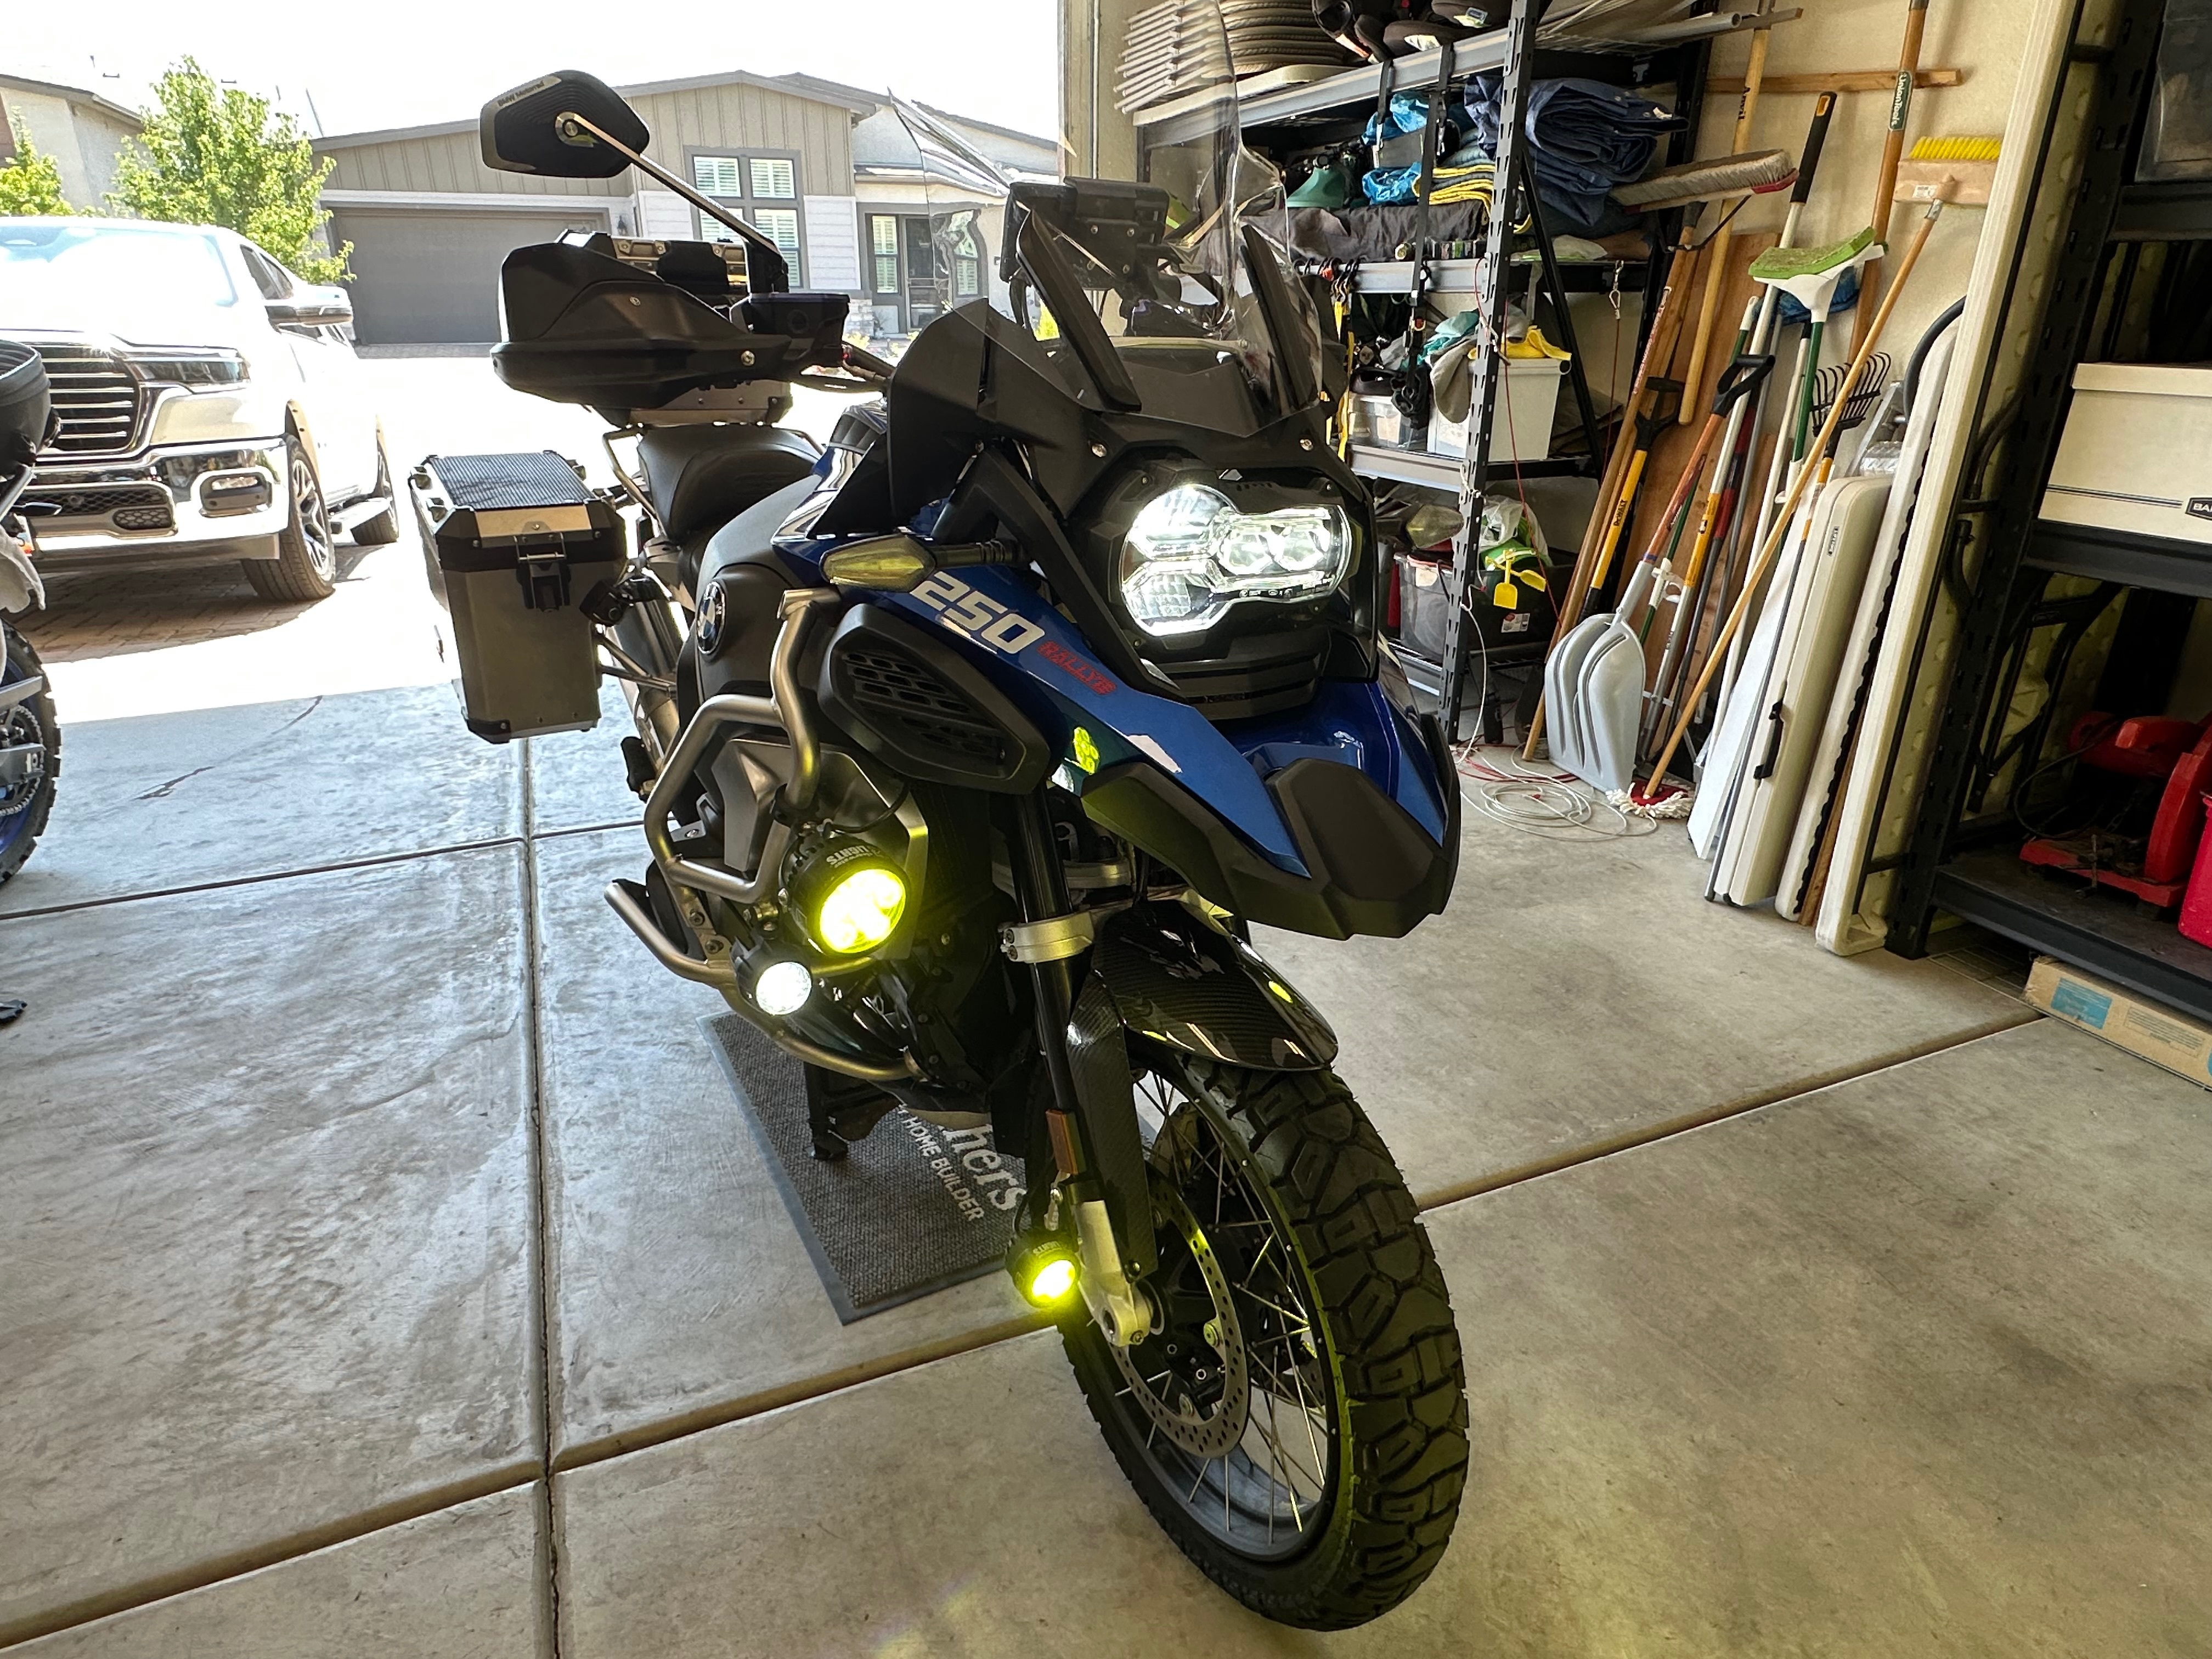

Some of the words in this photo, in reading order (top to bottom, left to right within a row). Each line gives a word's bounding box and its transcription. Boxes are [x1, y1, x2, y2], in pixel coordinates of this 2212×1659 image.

[1737, 87, 1751, 120] Anvil
[2193, 503, 2212, 512] BA
[826, 845, 870, 865] LIGHTS
[901, 1116, 942, 1156] HOME
[930, 1157, 984, 1221] BUILDER
[938, 1124, 1027, 1210] hers
